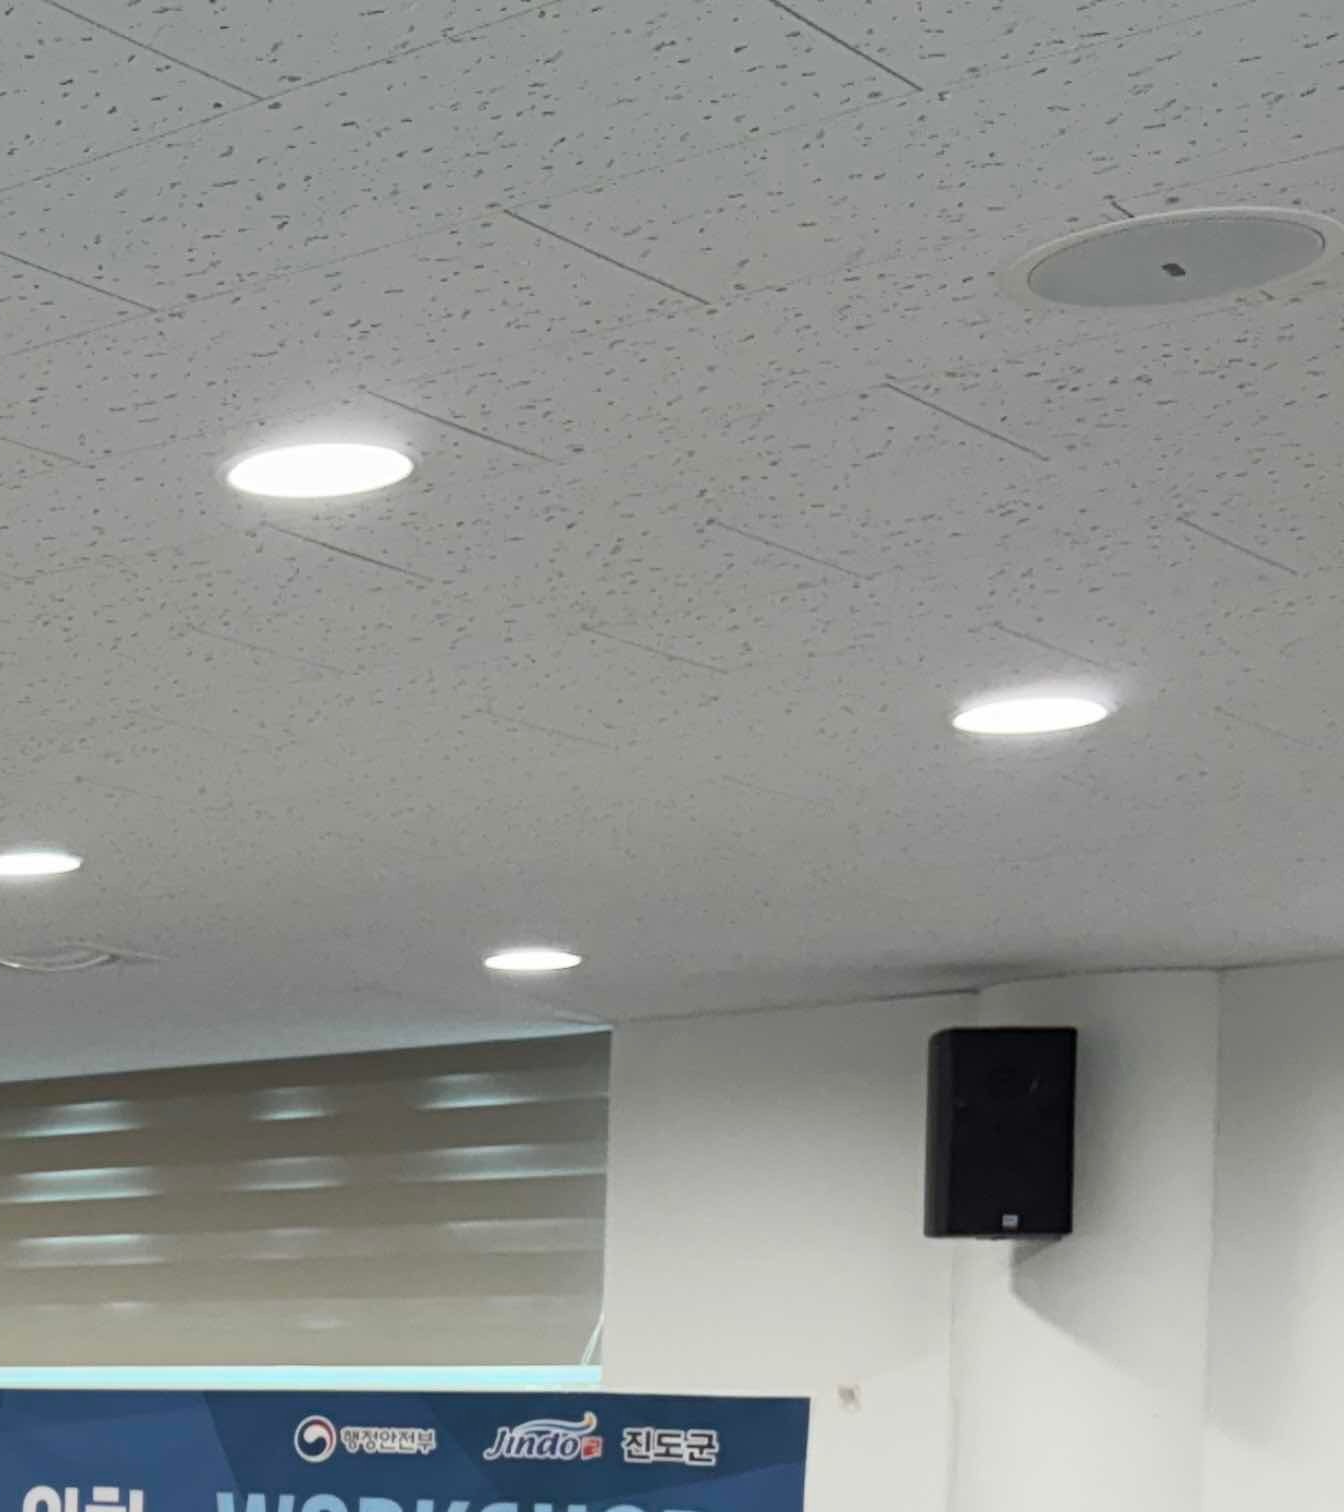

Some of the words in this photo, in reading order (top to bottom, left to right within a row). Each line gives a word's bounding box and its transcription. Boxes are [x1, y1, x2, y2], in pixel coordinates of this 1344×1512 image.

[341, 1427, 437, 1454] 행정안전부
[483, 1424, 582, 1461] Jindo
[622, 1427, 719, 1467] 진도군
